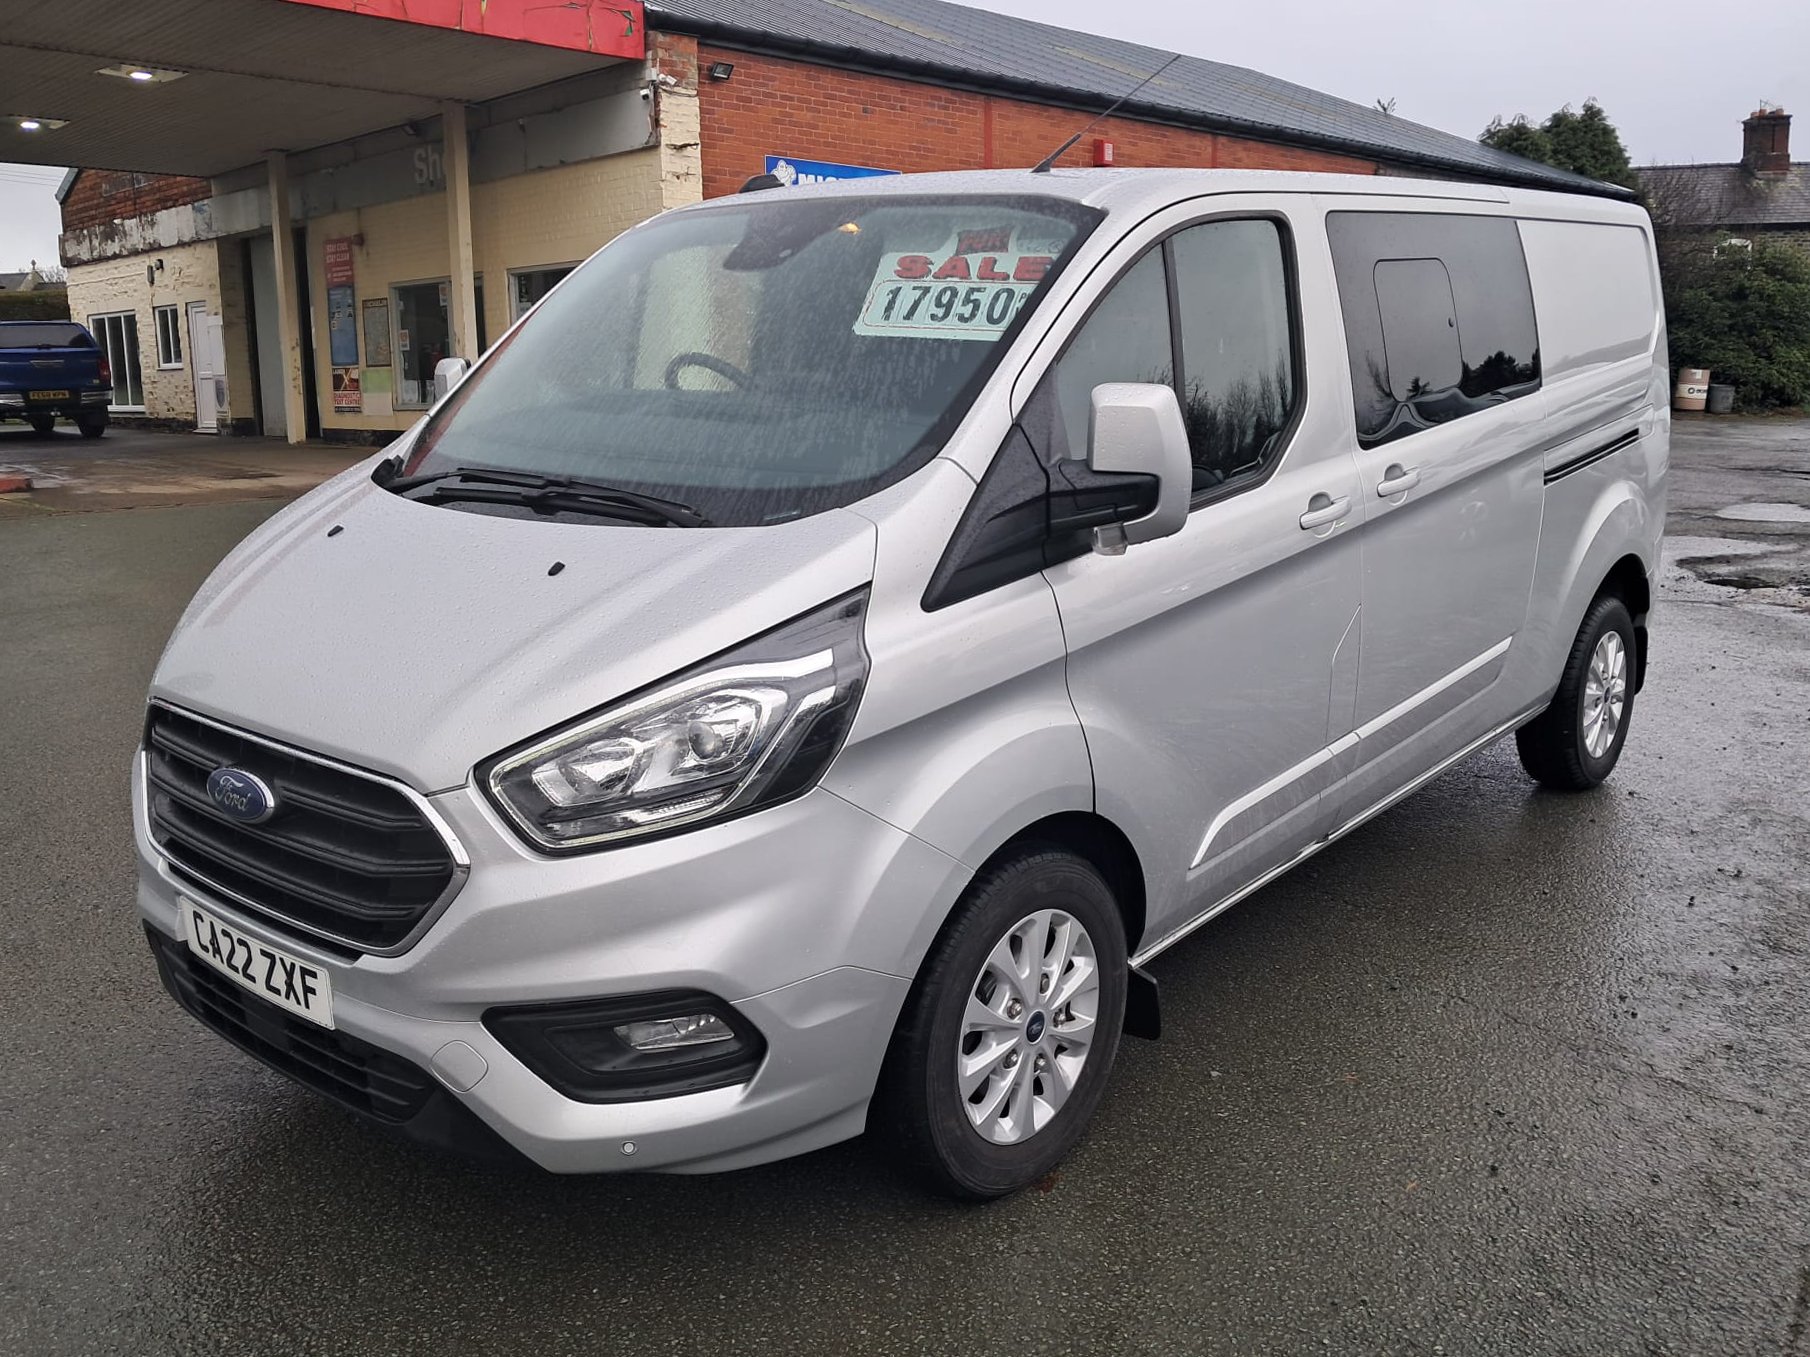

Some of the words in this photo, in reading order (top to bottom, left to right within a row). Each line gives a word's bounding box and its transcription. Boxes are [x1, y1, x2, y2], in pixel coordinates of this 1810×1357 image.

[894, 255, 1055, 281] SALE
[882, 286, 1016, 325] 17950
[214, 775, 252, 812] Ford
[193, 910, 257, 984] CA22
[259, 948, 318, 1010] ZXF
